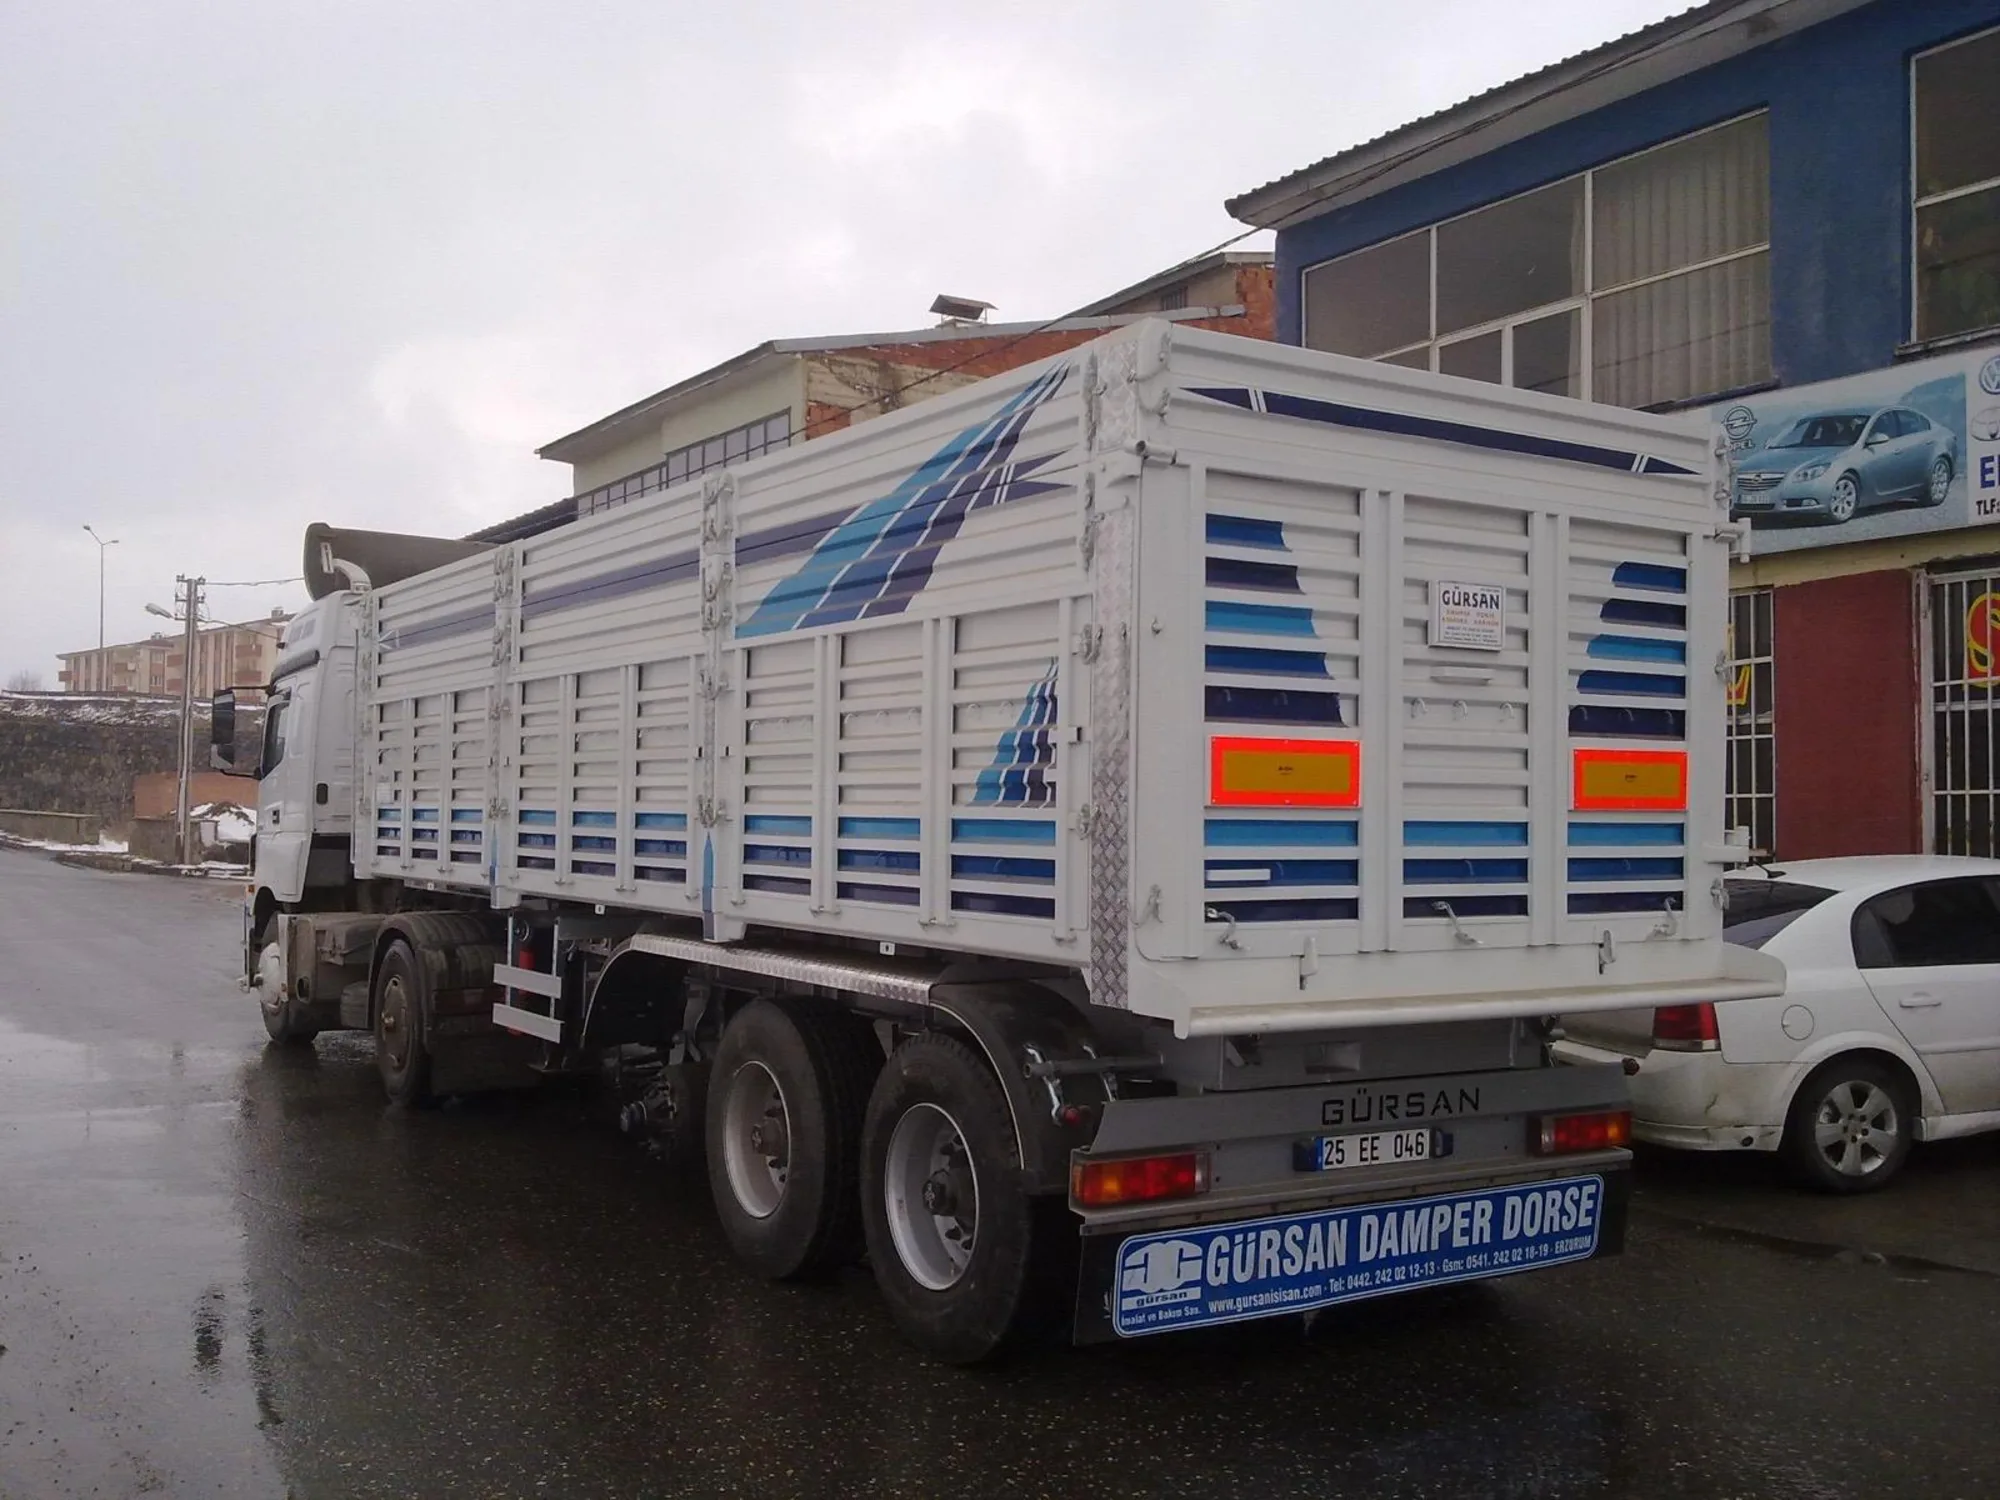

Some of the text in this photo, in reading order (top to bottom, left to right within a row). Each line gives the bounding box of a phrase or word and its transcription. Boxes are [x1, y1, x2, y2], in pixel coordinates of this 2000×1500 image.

[1442, 586, 1500, 610] GÜRSAN
[1321, 1087, 1480, 1126] GÜRSAN
[1324, 1132, 1425, 1166] 25 EE 046
[1206, 1184, 1596, 1287] GÜRSAN DAMPER DORSE
[1208, 1284, 1322, 1313] www.gursanisisan.com
[1329, 1278, 1345, 1293] Tel:
[1375, 1268, 1392, 1284] 242
[1394, 1265, 1406, 1281] 02
[1409, 1261, 1435, 1278] 12-13
[1442, 1257, 1464, 1273] Gsm:
[1493, 1250, 1510, 1266] 242
[1512, 1247, 1522, 1262] 02
